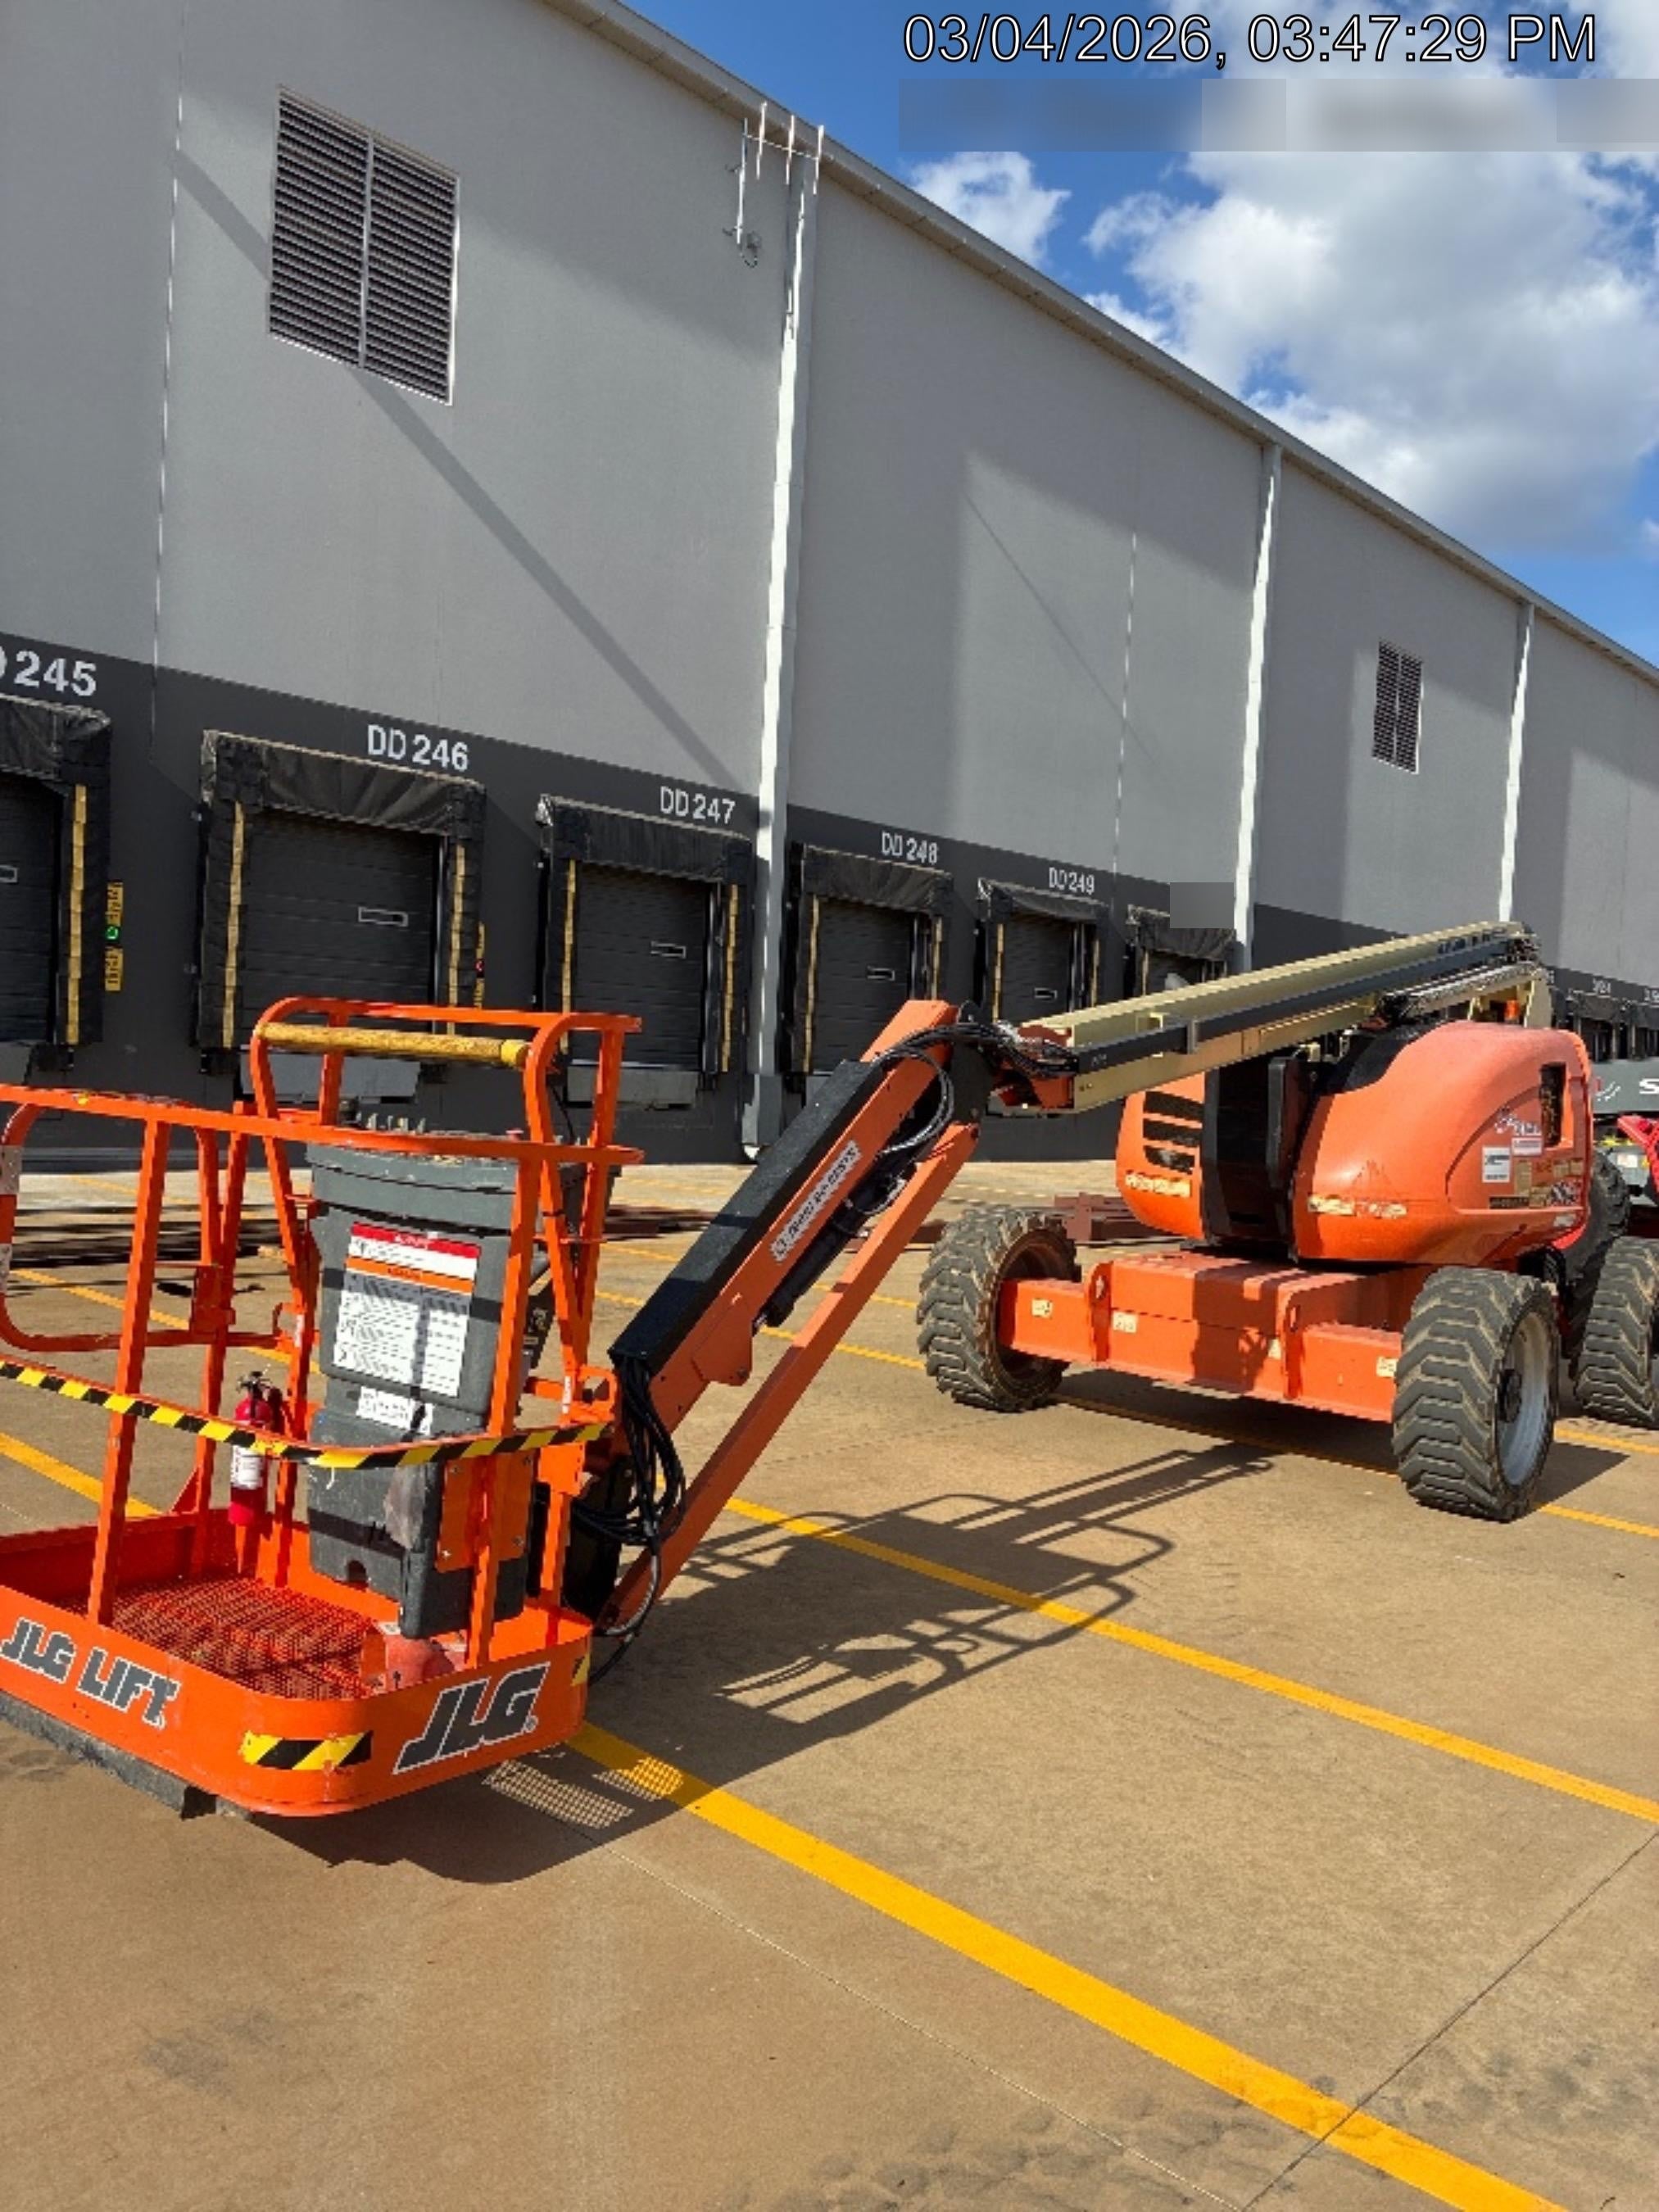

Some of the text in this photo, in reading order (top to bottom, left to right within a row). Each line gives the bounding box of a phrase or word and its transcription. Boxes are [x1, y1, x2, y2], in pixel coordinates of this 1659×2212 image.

[14, 650, 97, 696] 245
[368, 724, 469, 772] DD 246
[660, 786, 736, 824] DD 247
[906, 837, 939, 865] 248
[1068, 872, 1095, 895] 249
[0, 1617, 181, 1729] JLG LIFT
[392, 1661, 551, 1775] JLG
